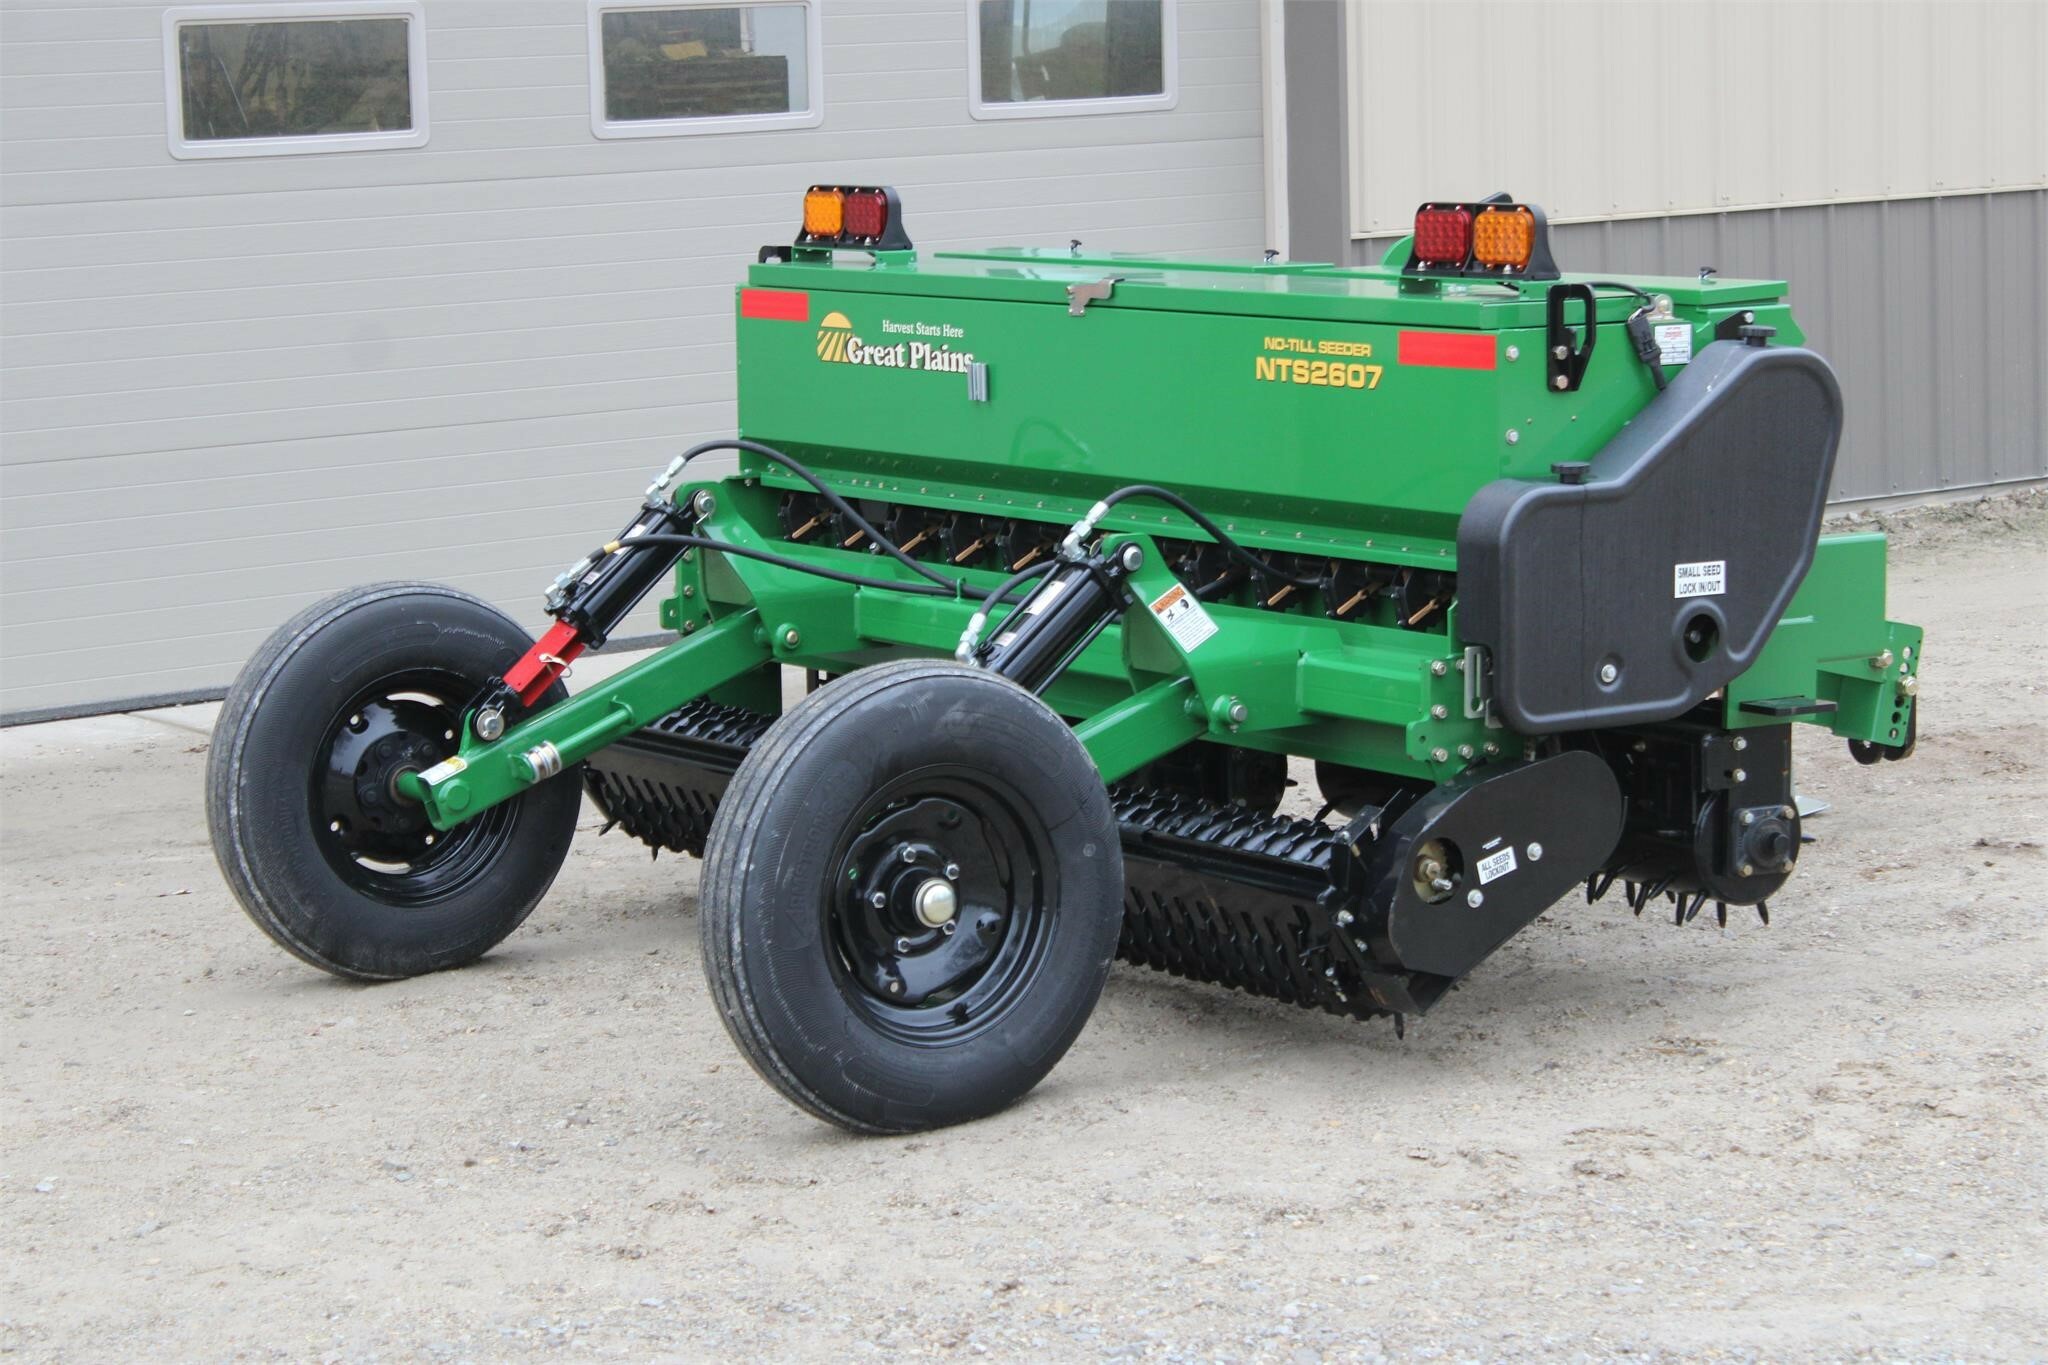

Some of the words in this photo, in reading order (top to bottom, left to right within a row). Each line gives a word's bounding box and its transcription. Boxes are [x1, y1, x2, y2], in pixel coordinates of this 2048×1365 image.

[882, 319, 915, 335] Harvest
[916, 322, 941, 337] Starts
[943, 324, 964, 338] Here
[846, 336, 905, 368] Great
[908, 341, 974, 373] Plains
[1263, 336, 1316, 353] NO-TILL
[1318, 341, 1372, 357] SEEDER
[1255, 356, 1383, 390] NTS2607
[1678, 567, 1701, 578] SMALL
[1703, 564, 1721, 576] SEED
[1679, 582, 1697, 594] LOCK
[1481, 861, 1492, 872] ALL
[1493, 852, 1511, 867] SEEDS
